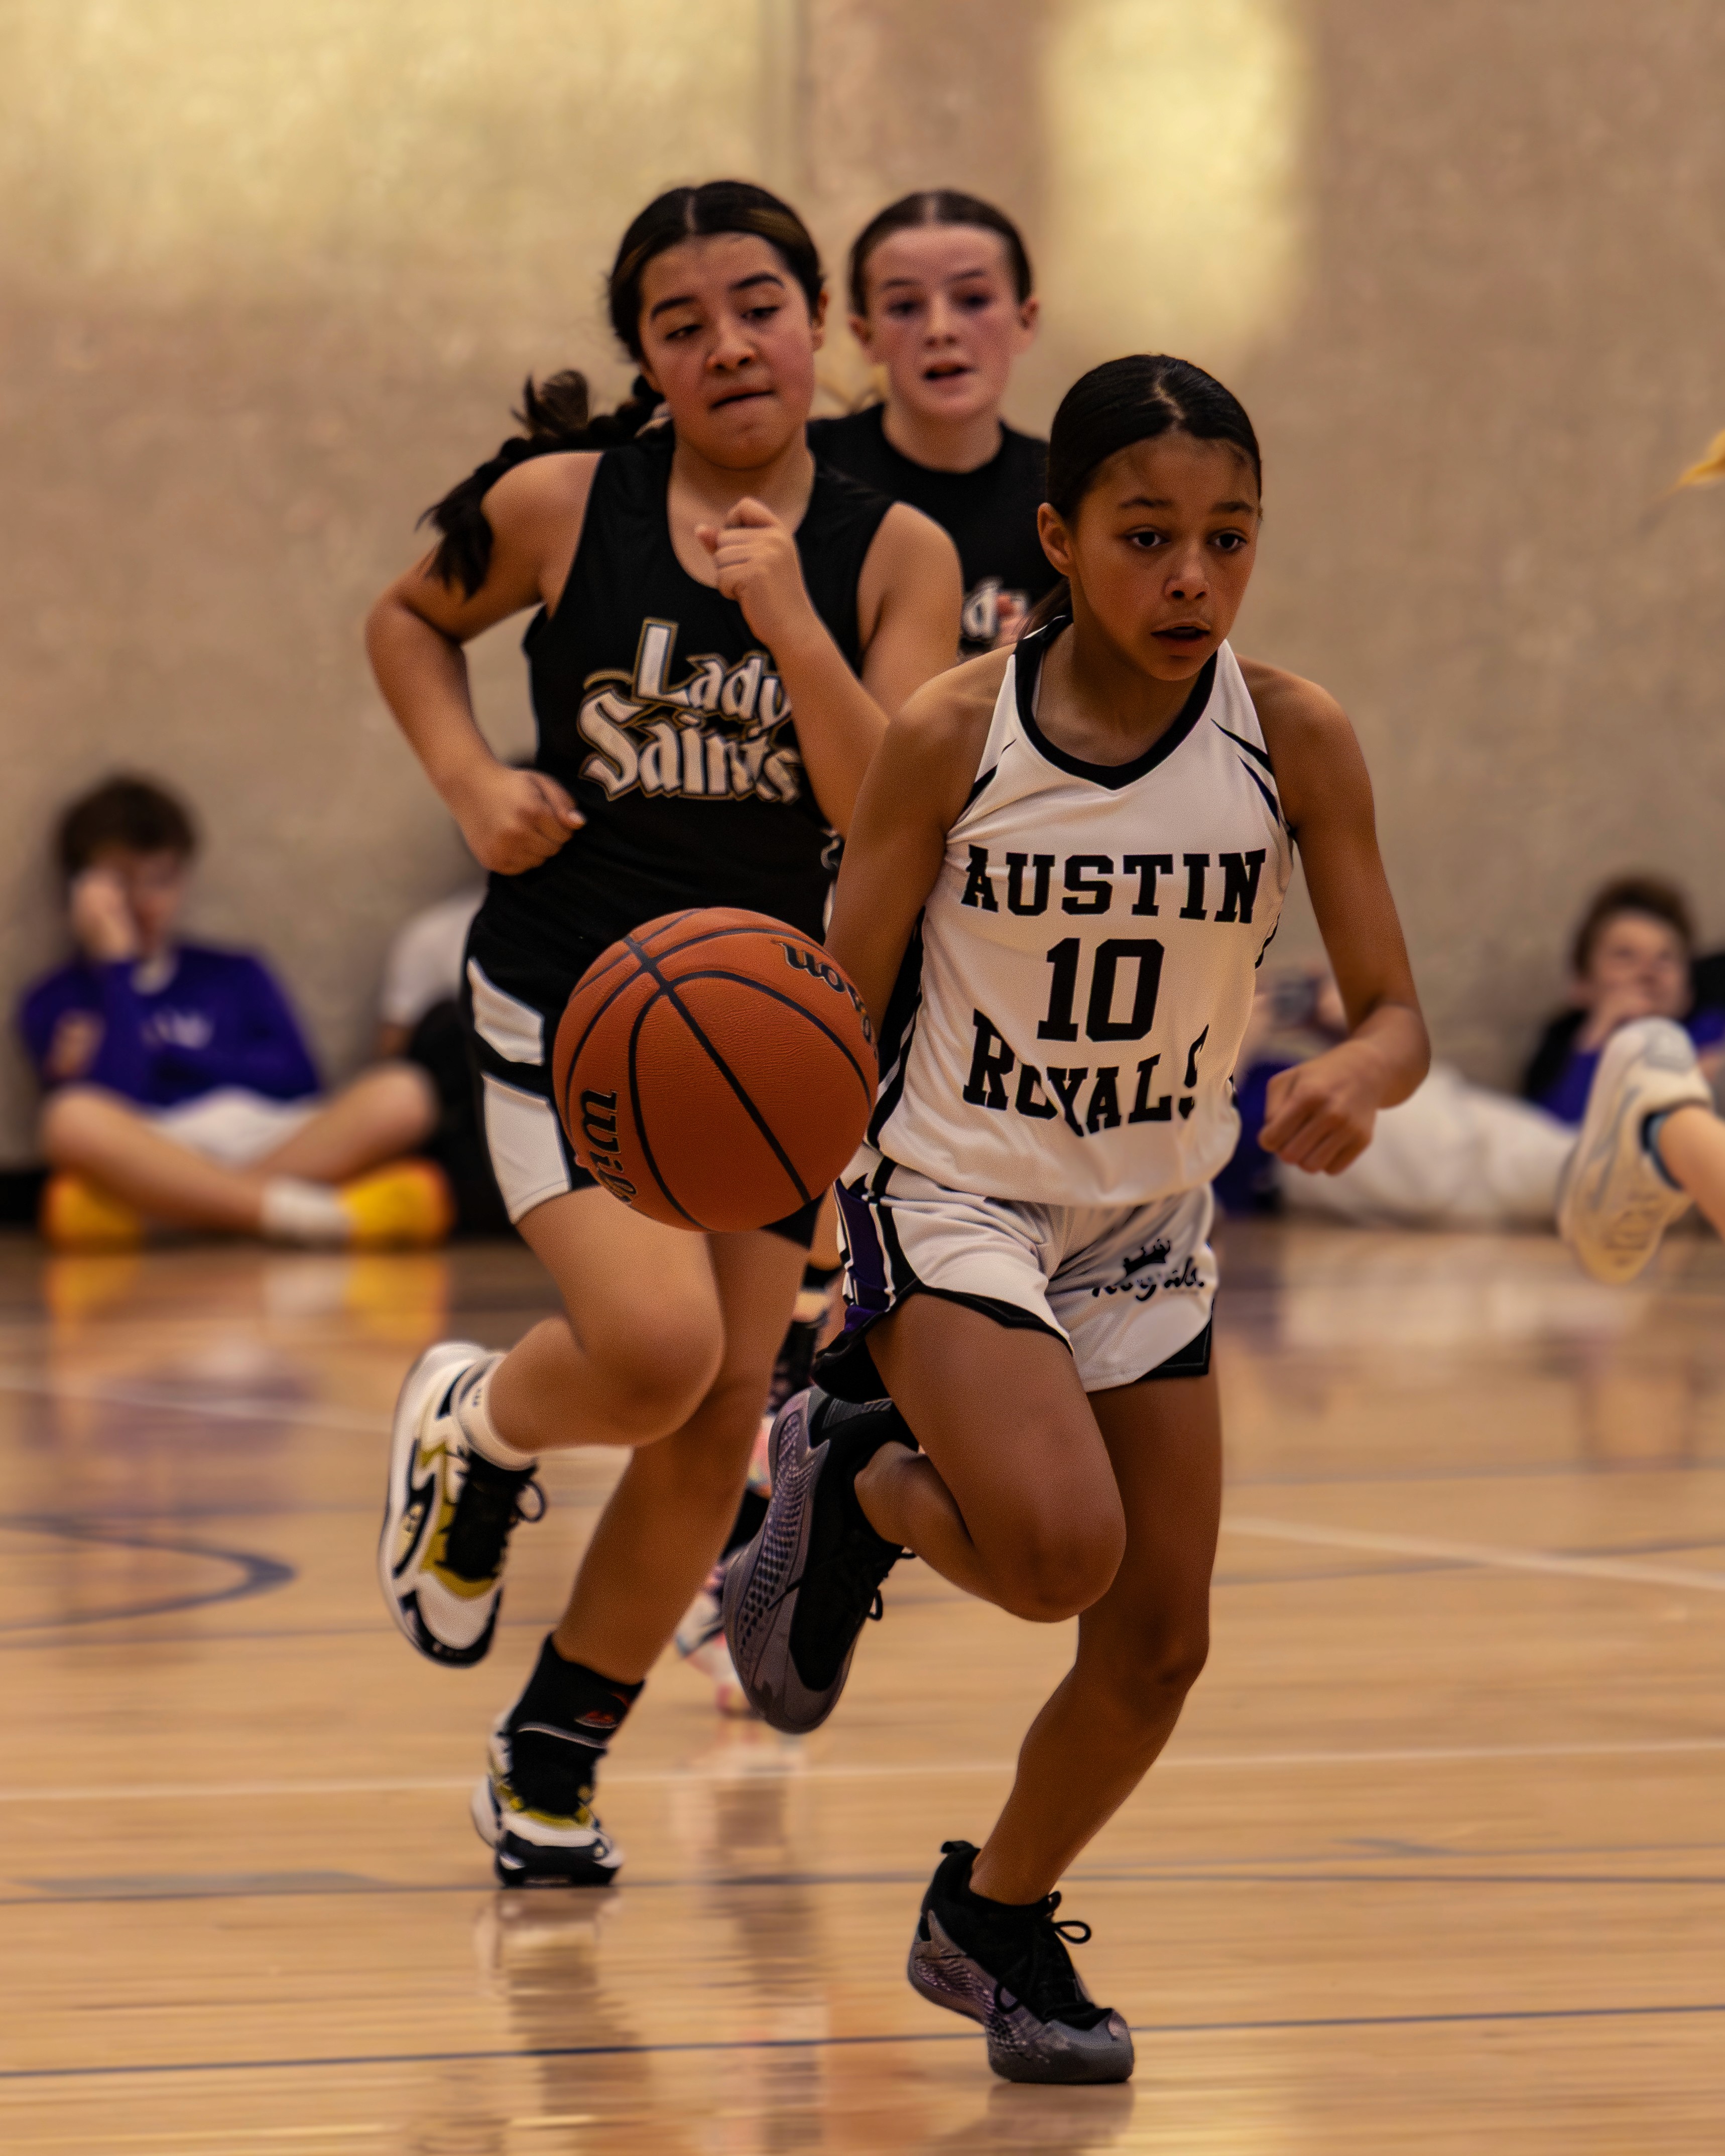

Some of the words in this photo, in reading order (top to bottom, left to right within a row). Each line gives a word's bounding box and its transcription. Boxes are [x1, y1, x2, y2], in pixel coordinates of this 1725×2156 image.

[633, 617, 792, 739] Lady
[577, 685, 802, 803] Saints
[960, 844, 1266, 924] AUSTIN
[1037, 937, 1165, 1042] 10
